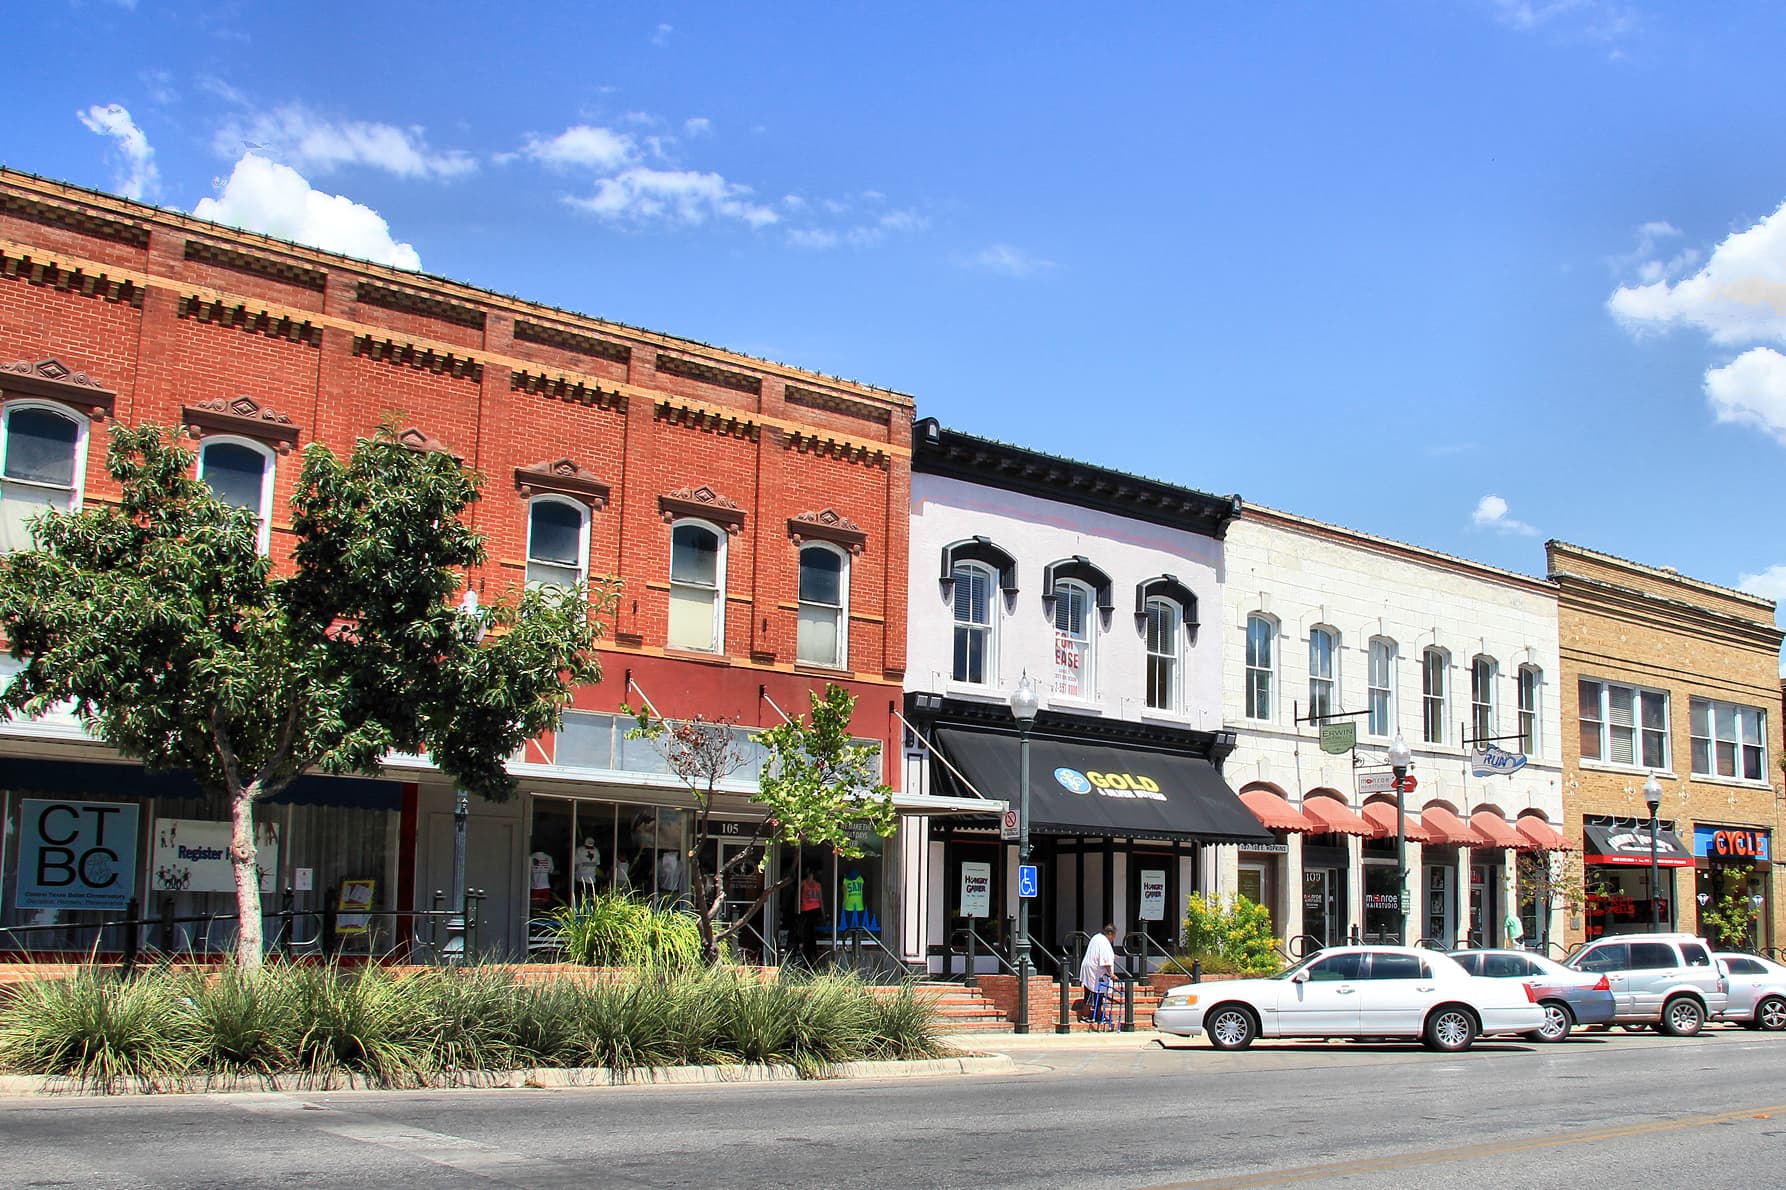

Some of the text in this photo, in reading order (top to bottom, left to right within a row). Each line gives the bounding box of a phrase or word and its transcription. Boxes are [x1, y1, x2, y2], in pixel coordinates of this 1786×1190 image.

[1056, 631, 1074, 649] FOR
[1056, 650, 1079, 669] EASE
[1322, 728, 1353, 737] ERWIN
[1483, 753, 1508, 767] RUN
[1086, 771, 1160, 792] GOLD
[38, 804, 120, 847] CT
[721, 823, 739, 834] 105
[1715, 830, 1765, 856] CYCLE
[178, 845, 224, 861] Register
[36, 847, 120, 889] BC
[1365, 894, 1398, 902] monroe
